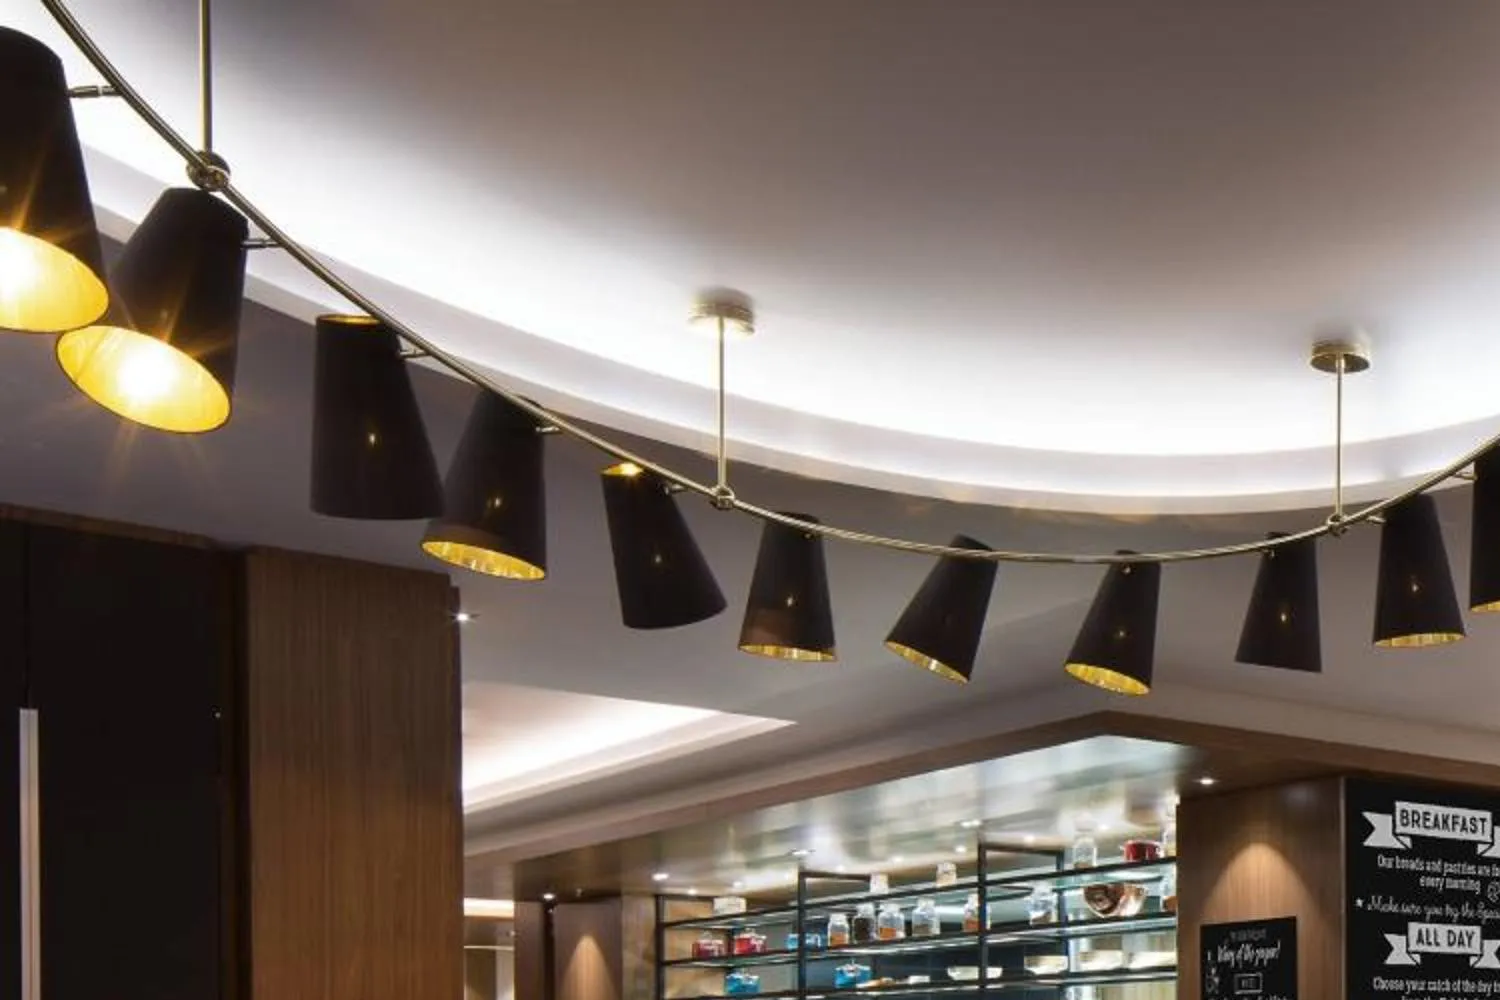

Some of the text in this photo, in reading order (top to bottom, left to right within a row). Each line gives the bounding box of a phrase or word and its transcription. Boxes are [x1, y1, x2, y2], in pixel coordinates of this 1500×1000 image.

[1400, 809, 1487, 835] BREAKFAST
[1416, 928, 1476, 948] ALL DAY
